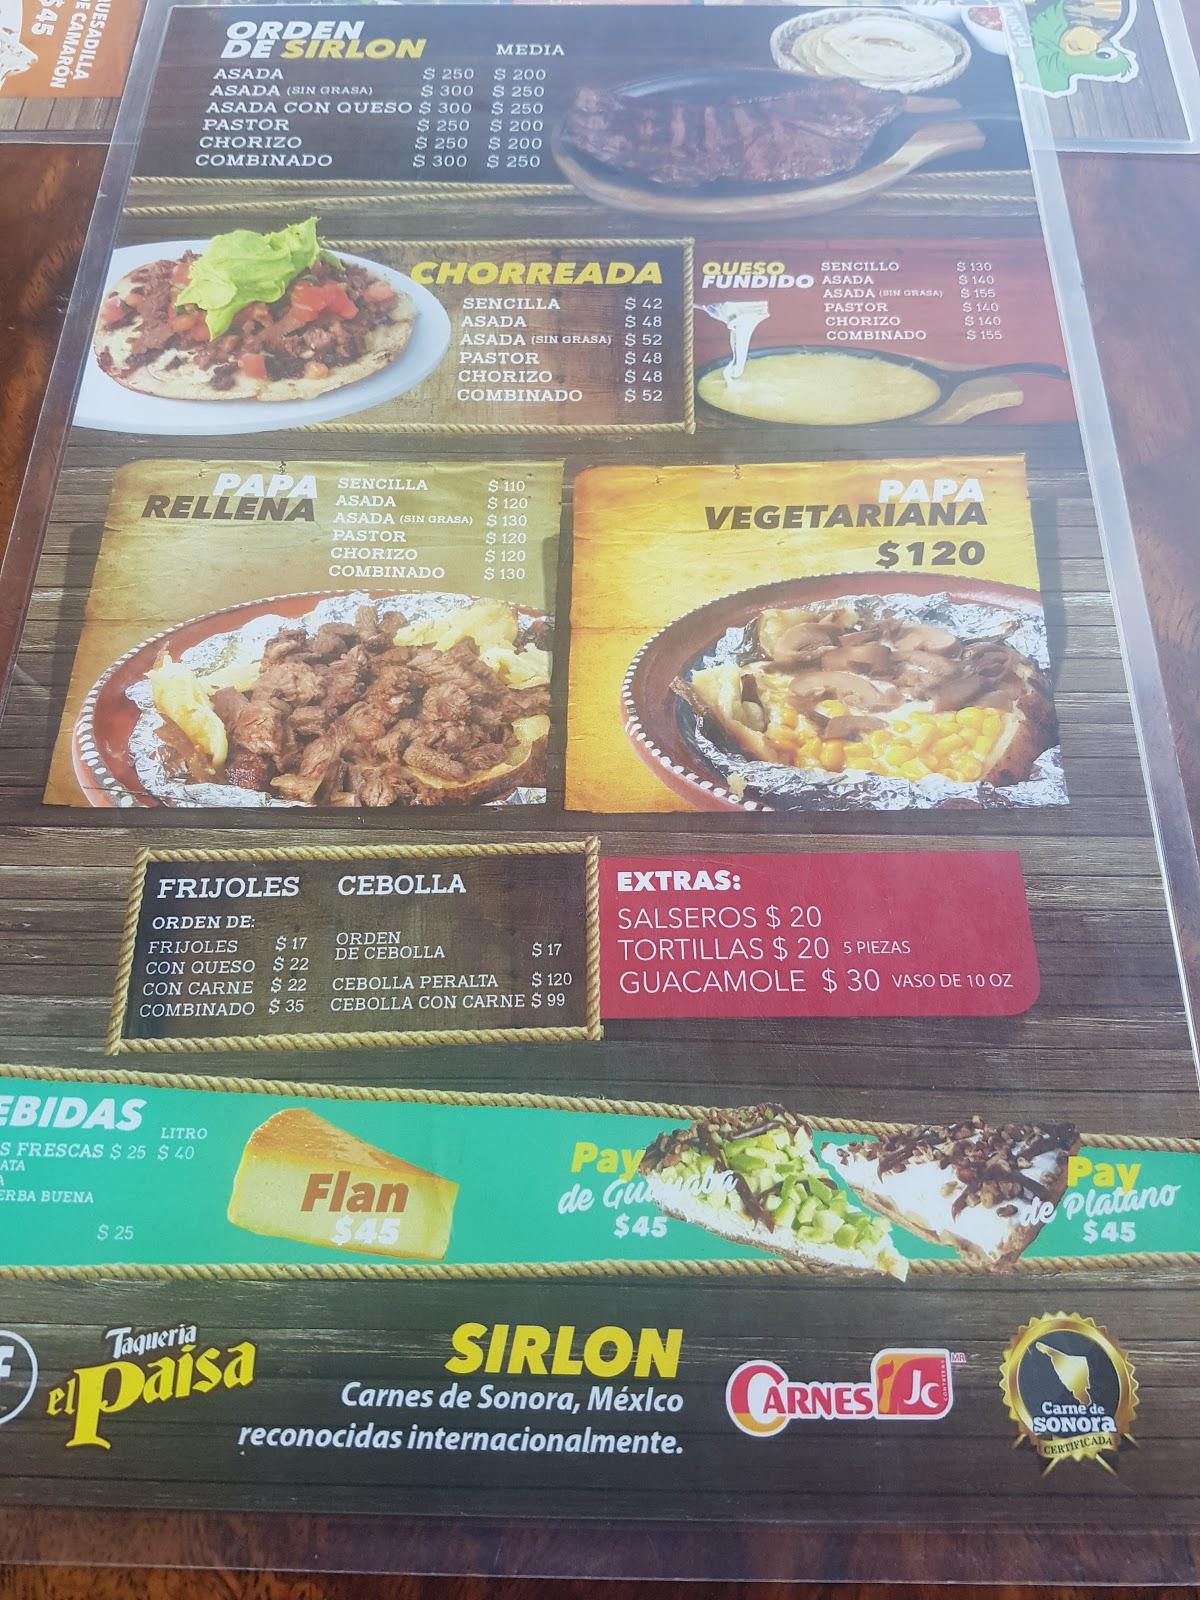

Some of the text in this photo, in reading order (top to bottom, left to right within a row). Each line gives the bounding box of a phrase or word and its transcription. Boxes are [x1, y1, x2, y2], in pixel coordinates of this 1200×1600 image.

[226, 20, 365, 40] ORDEN
[73, 0, 111, 80] UESADILLA
[221, 38, 427, 60] DE SIRLON
[496, 43, 565, 57] MEDIA
[213, 68, 546, 80] ASADA 250 200
[209, 85, 545, 97] ASADA (SIN GRASA) 300 250
[205, 102, 544, 115] ASADA CON QUESO 300 250
[202, 119, 544, 132] PASTOR 250 200
[199, 136, 542, 149] CHORIZO 250 200
[195, 154, 541, 168] COMBINADO 300 250
[410, 262, 662, 285] CHORREADA
[702, 262, 785, 276] QUESO
[821, 262, 992, 272] SENCILLO 130
[701, 275, 815, 289] FUNDIDO
[822, 276, 994, 285] ASADA 140
[823, 289, 876, 298] ASADA
[974, 289, 995, 298] 155
[463, 298, 662, 310] SENCILLA 42
[824, 303, 999, 312] PASTOR 140
[461, 316, 662, 328] ASADA 48
[825, 317, 900, 326] CHORIZO
[460, 334, 662, 345] ASADA (SIN GRASA) 52
[826, 331, 927, 341] COMBINADO
[459, 352, 662, 364] PASTOR 48
[458, 370, 662, 383] CHORIZO 48
[457, 390, 662, 402] COMBINADO 52
[212, 473, 319, 498] PAPA
[337, 478, 526, 492] SENCILLA 110
[879, 479, 985, 503] PAPA
[141, 495, 316, 522] RELLENA
[336, 495, 528, 509] ASADA 120
[333, 512, 527, 526] ASADA (SIN GRASA) 130
[705, 501, 988, 530] VEGETARIANA
[332, 530, 527, 544] PASTOR 120
[330, 547, 526, 562] CHORIZO 120
[876, 540, 986, 569] $120
[328, 565, 525, 580] COMBINADO 130
[157, 877, 300, 899] FRIJOLES
[338, 874, 467, 896] CEBOLLA
[617, 869, 742, 892] EXTRAS:
[152, 915, 255, 930] ORDEN DE:
[617, 905, 822, 930] SALSEROS 20
[148, 937, 308, 954] FRIJOLES 17
[336, 931, 401, 945] ORDEN
[335, 943, 562, 961] DE CEBOLLA 17
[618, 937, 911, 961] TORTILLAS 20 5 PIEZAS
[145, 958, 309, 975] CON QUESO 22
[143, 979, 307, 996] CON CARNE 22
[332, 972, 573, 991] CEBOLLA PERALTA 120
[619, 968, 1014, 994] GUACAMOLE 30 VASO DE 10 OZ
[139, 1000, 304, 1018] COMBINADO 35
[330, 993, 565, 1012] CEBOLLA CON CARNE 99
[160, 1128, 208, 1140] LITRO
[16, 1142, 195, 1160] FRESCAS 25 40
[571, 1142, 646, 1182] Pay
[1067, 1155, 1142, 1195] Pay
[41, 1190, 94, 1203] BUENA
[300, 1171, 409, 1213] Flan
[557, 1183, 595, 1215] de
[1019, 1184, 1181, 1227] de Platano
[114, 1226, 134, 1240] 25
[331, 1214, 401, 1246] $45
[613, 1213, 668, 1239] $45
[1083, 1219, 1136, 1244] $45
[445, 1322, 684, 1378] SIRLON
[46, 1378, 76, 1416] el
[341, 1381, 434, 1408] Carnes
[439, 1382, 472, 1409] de
[477, 1383, 581, 1415] Sonora,
[1042, 1401, 1104, 1415] Carne de
[237, 1423, 684, 1455] reconocidas internacionalmente.
[1043, 1436, 1113, 1455] CERTIFICADA
